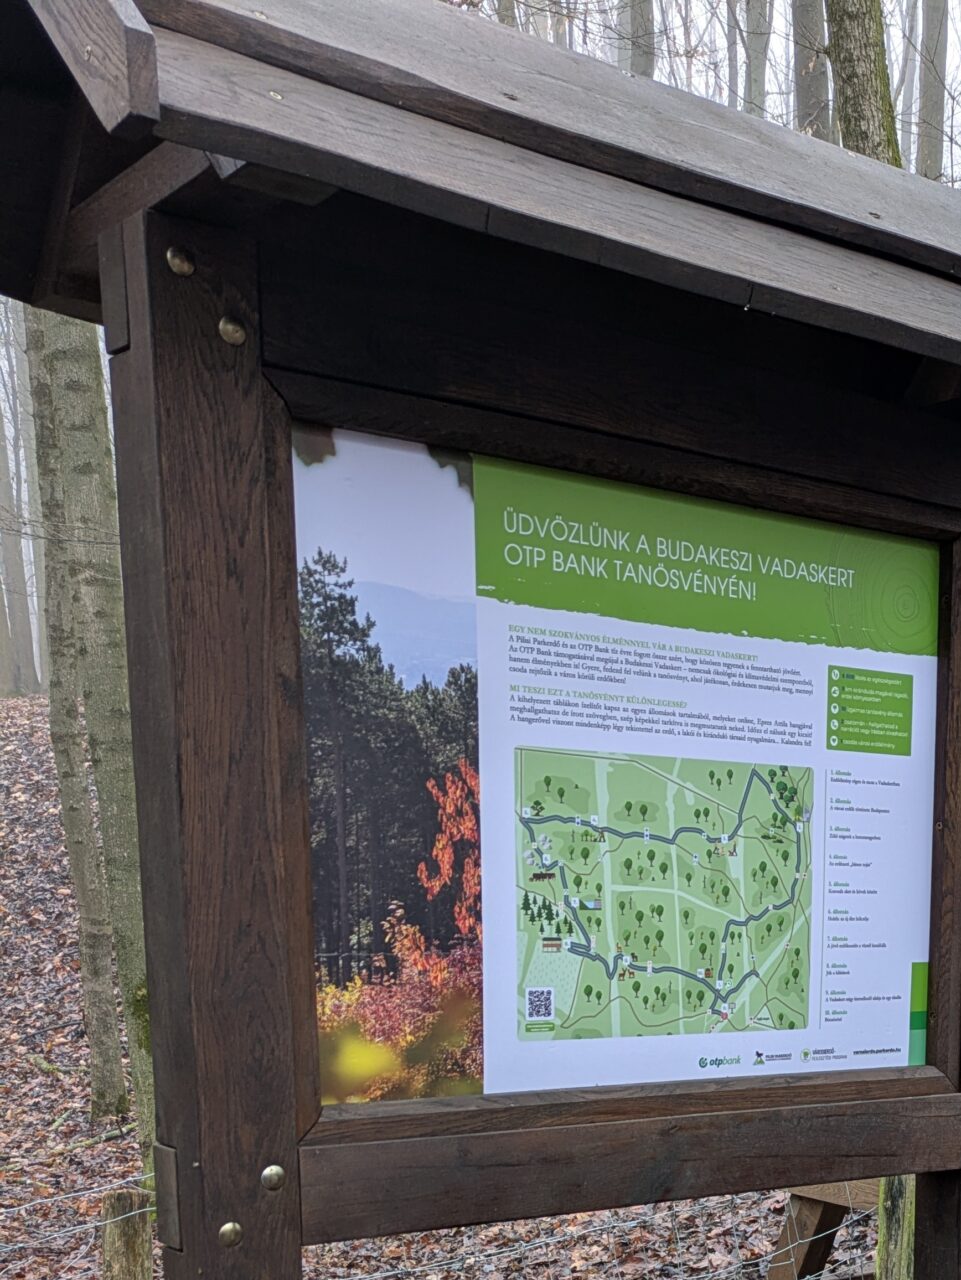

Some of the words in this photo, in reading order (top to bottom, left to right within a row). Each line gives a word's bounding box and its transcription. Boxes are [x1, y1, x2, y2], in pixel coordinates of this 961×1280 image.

[503, 508, 630, 553] ÜDVÖZLÜNK
[635, 533, 651, 556] A
[656, 537, 752, 573] BUDAKESZI
[758, 554, 855, 590] VADASKERT
[503, 543, 546, 570] OTP
[552, 551, 608, 580] BANK
[613, 557, 756, 602] TANÖSVÉNYÉN!
